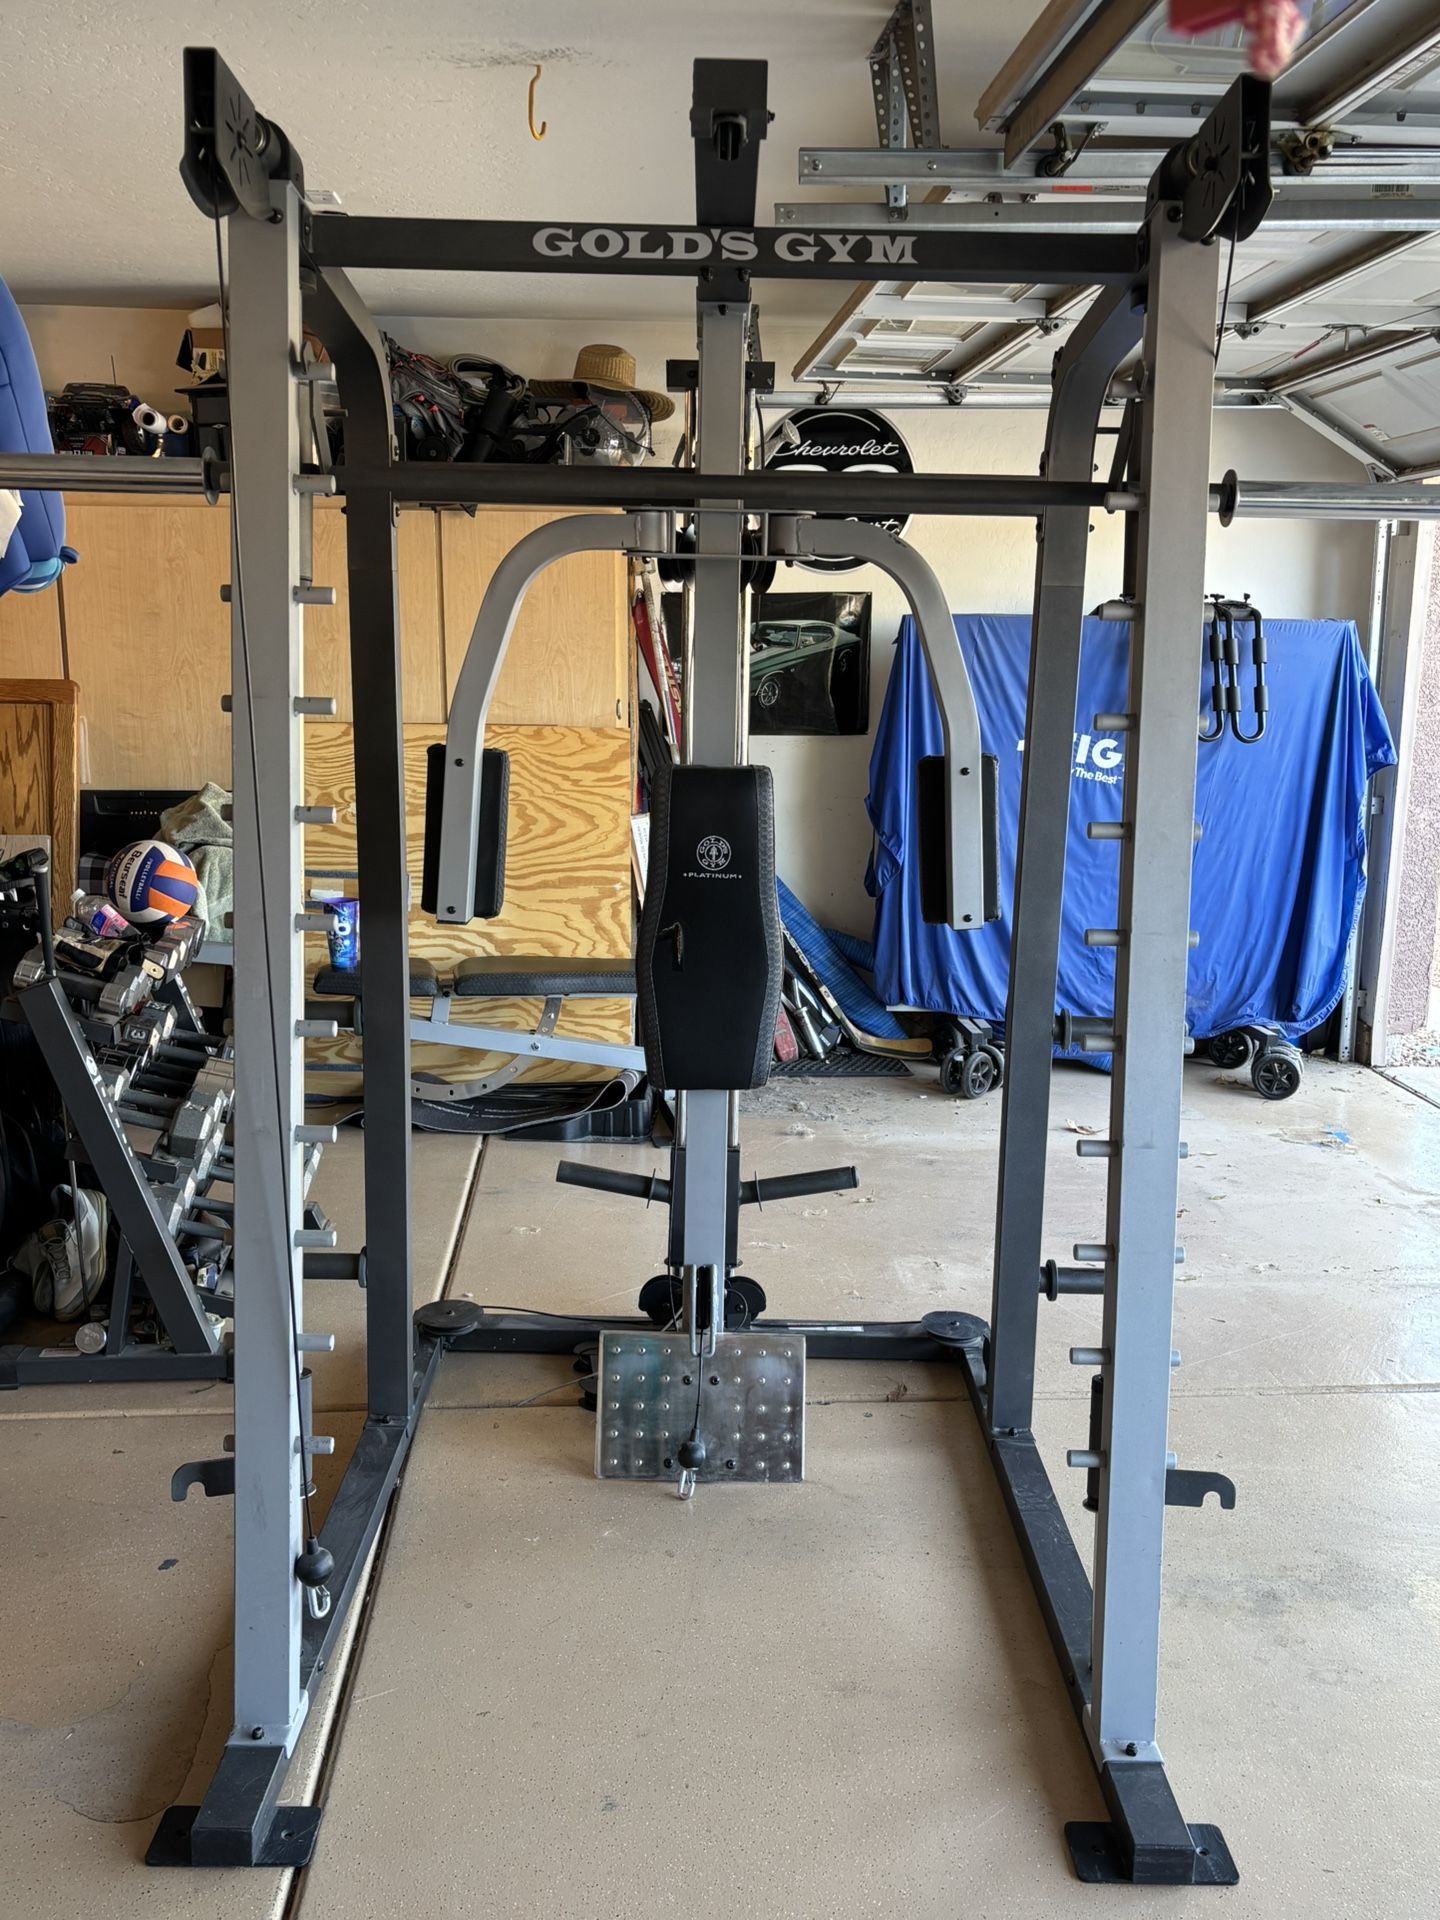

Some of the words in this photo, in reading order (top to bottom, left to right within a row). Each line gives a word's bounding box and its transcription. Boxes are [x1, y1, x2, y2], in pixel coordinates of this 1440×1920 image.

[532, 227, 758, 261] GOLD'S
[774, 232, 918, 264] GYM
[774, 439, 899, 456] Chevrolet
[1075, 767, 1094, 780] The
[688, 872, 737, 880] PLATINUM
